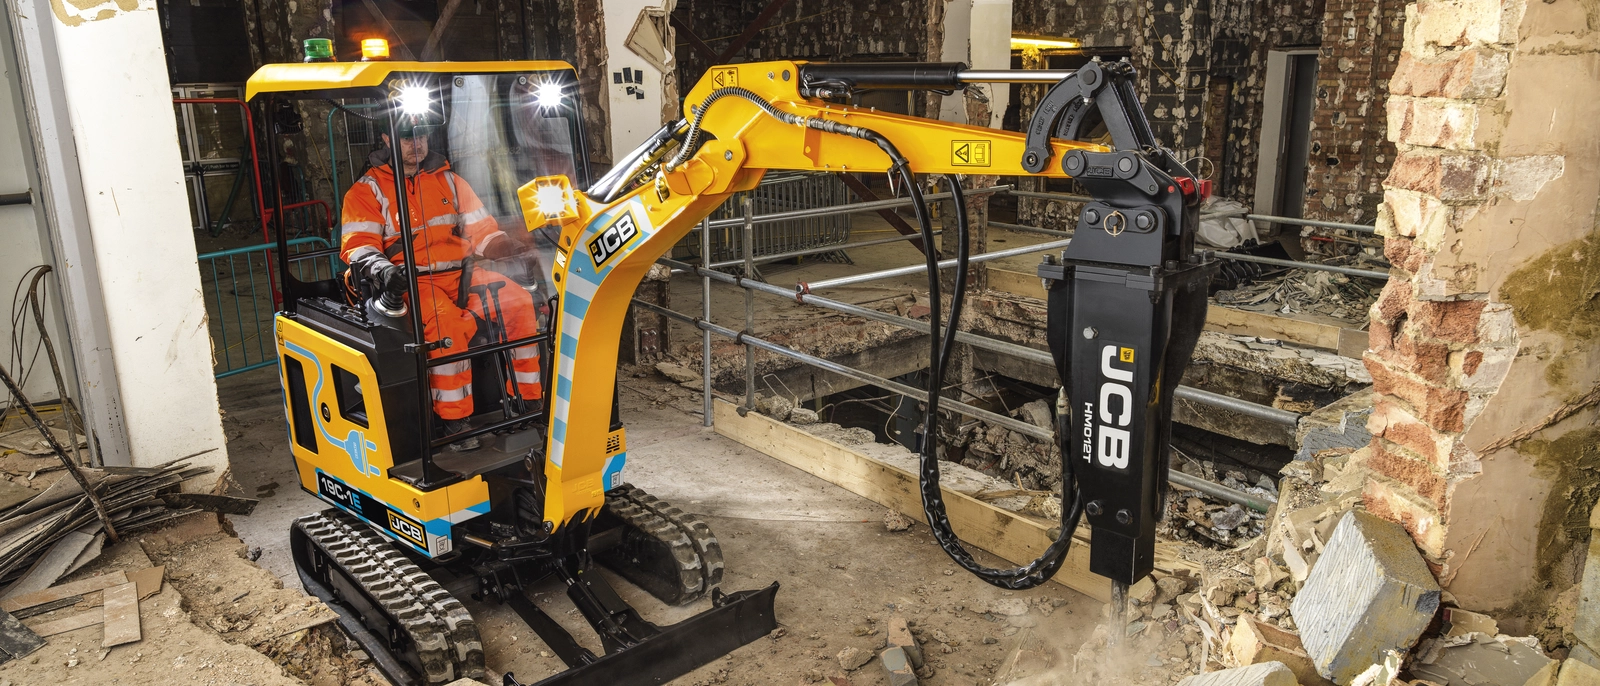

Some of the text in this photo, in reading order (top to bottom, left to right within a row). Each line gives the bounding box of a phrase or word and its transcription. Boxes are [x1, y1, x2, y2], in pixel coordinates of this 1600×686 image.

[594, 214, 636, 264] JCB
[1098, 345, 1133, 469] JCB
[1083, 402, 1093, 463] HM012T
[321, 477, 362, 510] 19C-1E
[391, 516, 422, 542] JCB
